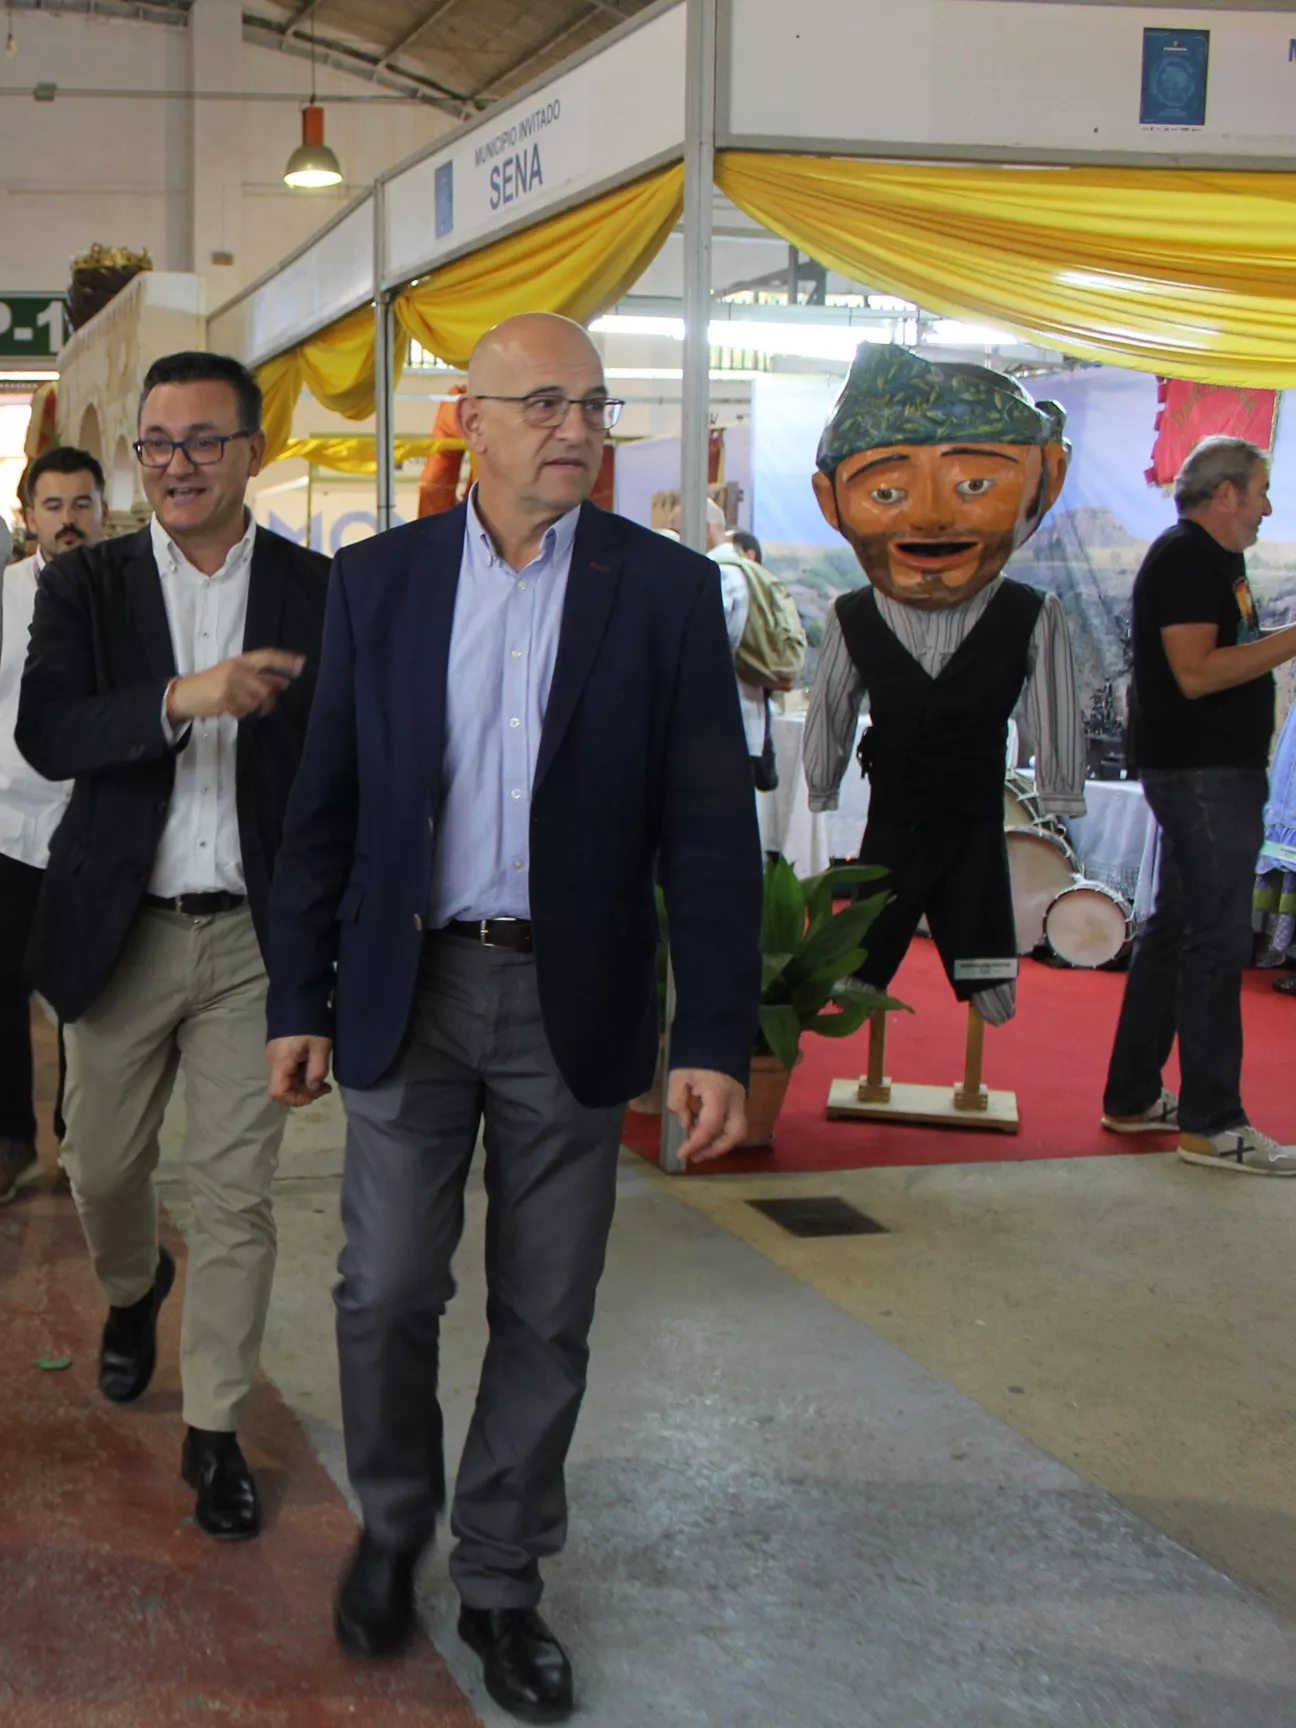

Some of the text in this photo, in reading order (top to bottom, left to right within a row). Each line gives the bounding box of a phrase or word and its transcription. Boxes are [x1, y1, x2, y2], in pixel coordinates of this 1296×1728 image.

[474, 99, 561, 168] MUNICIPIO INVITADO
[489, 143, 543, 211] SENA
